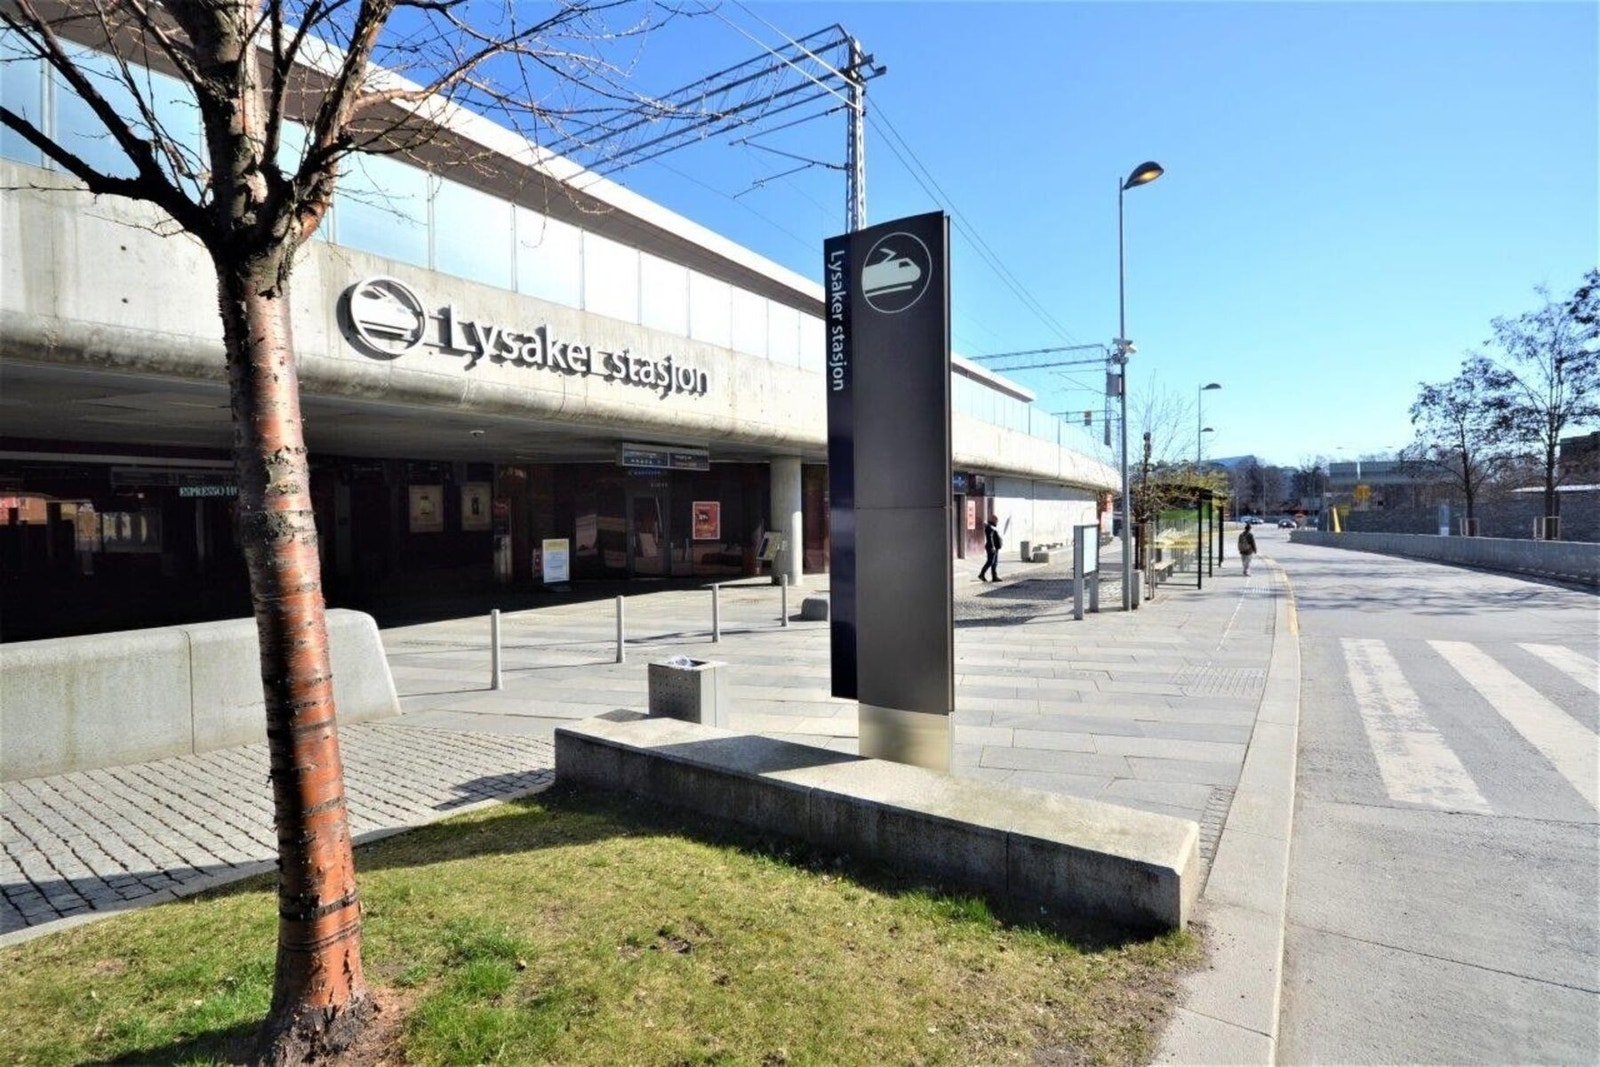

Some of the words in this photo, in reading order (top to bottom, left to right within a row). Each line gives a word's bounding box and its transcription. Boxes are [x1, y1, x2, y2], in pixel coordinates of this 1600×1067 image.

[828, 250, 846, 320] Lysaker
[448, 303, 604, 373] Lysaker
[611, 348, 707, 395] stasjon
[829, 326, 847, 391] stasjon
[179, 486, 225, 497] ESPRESSO
